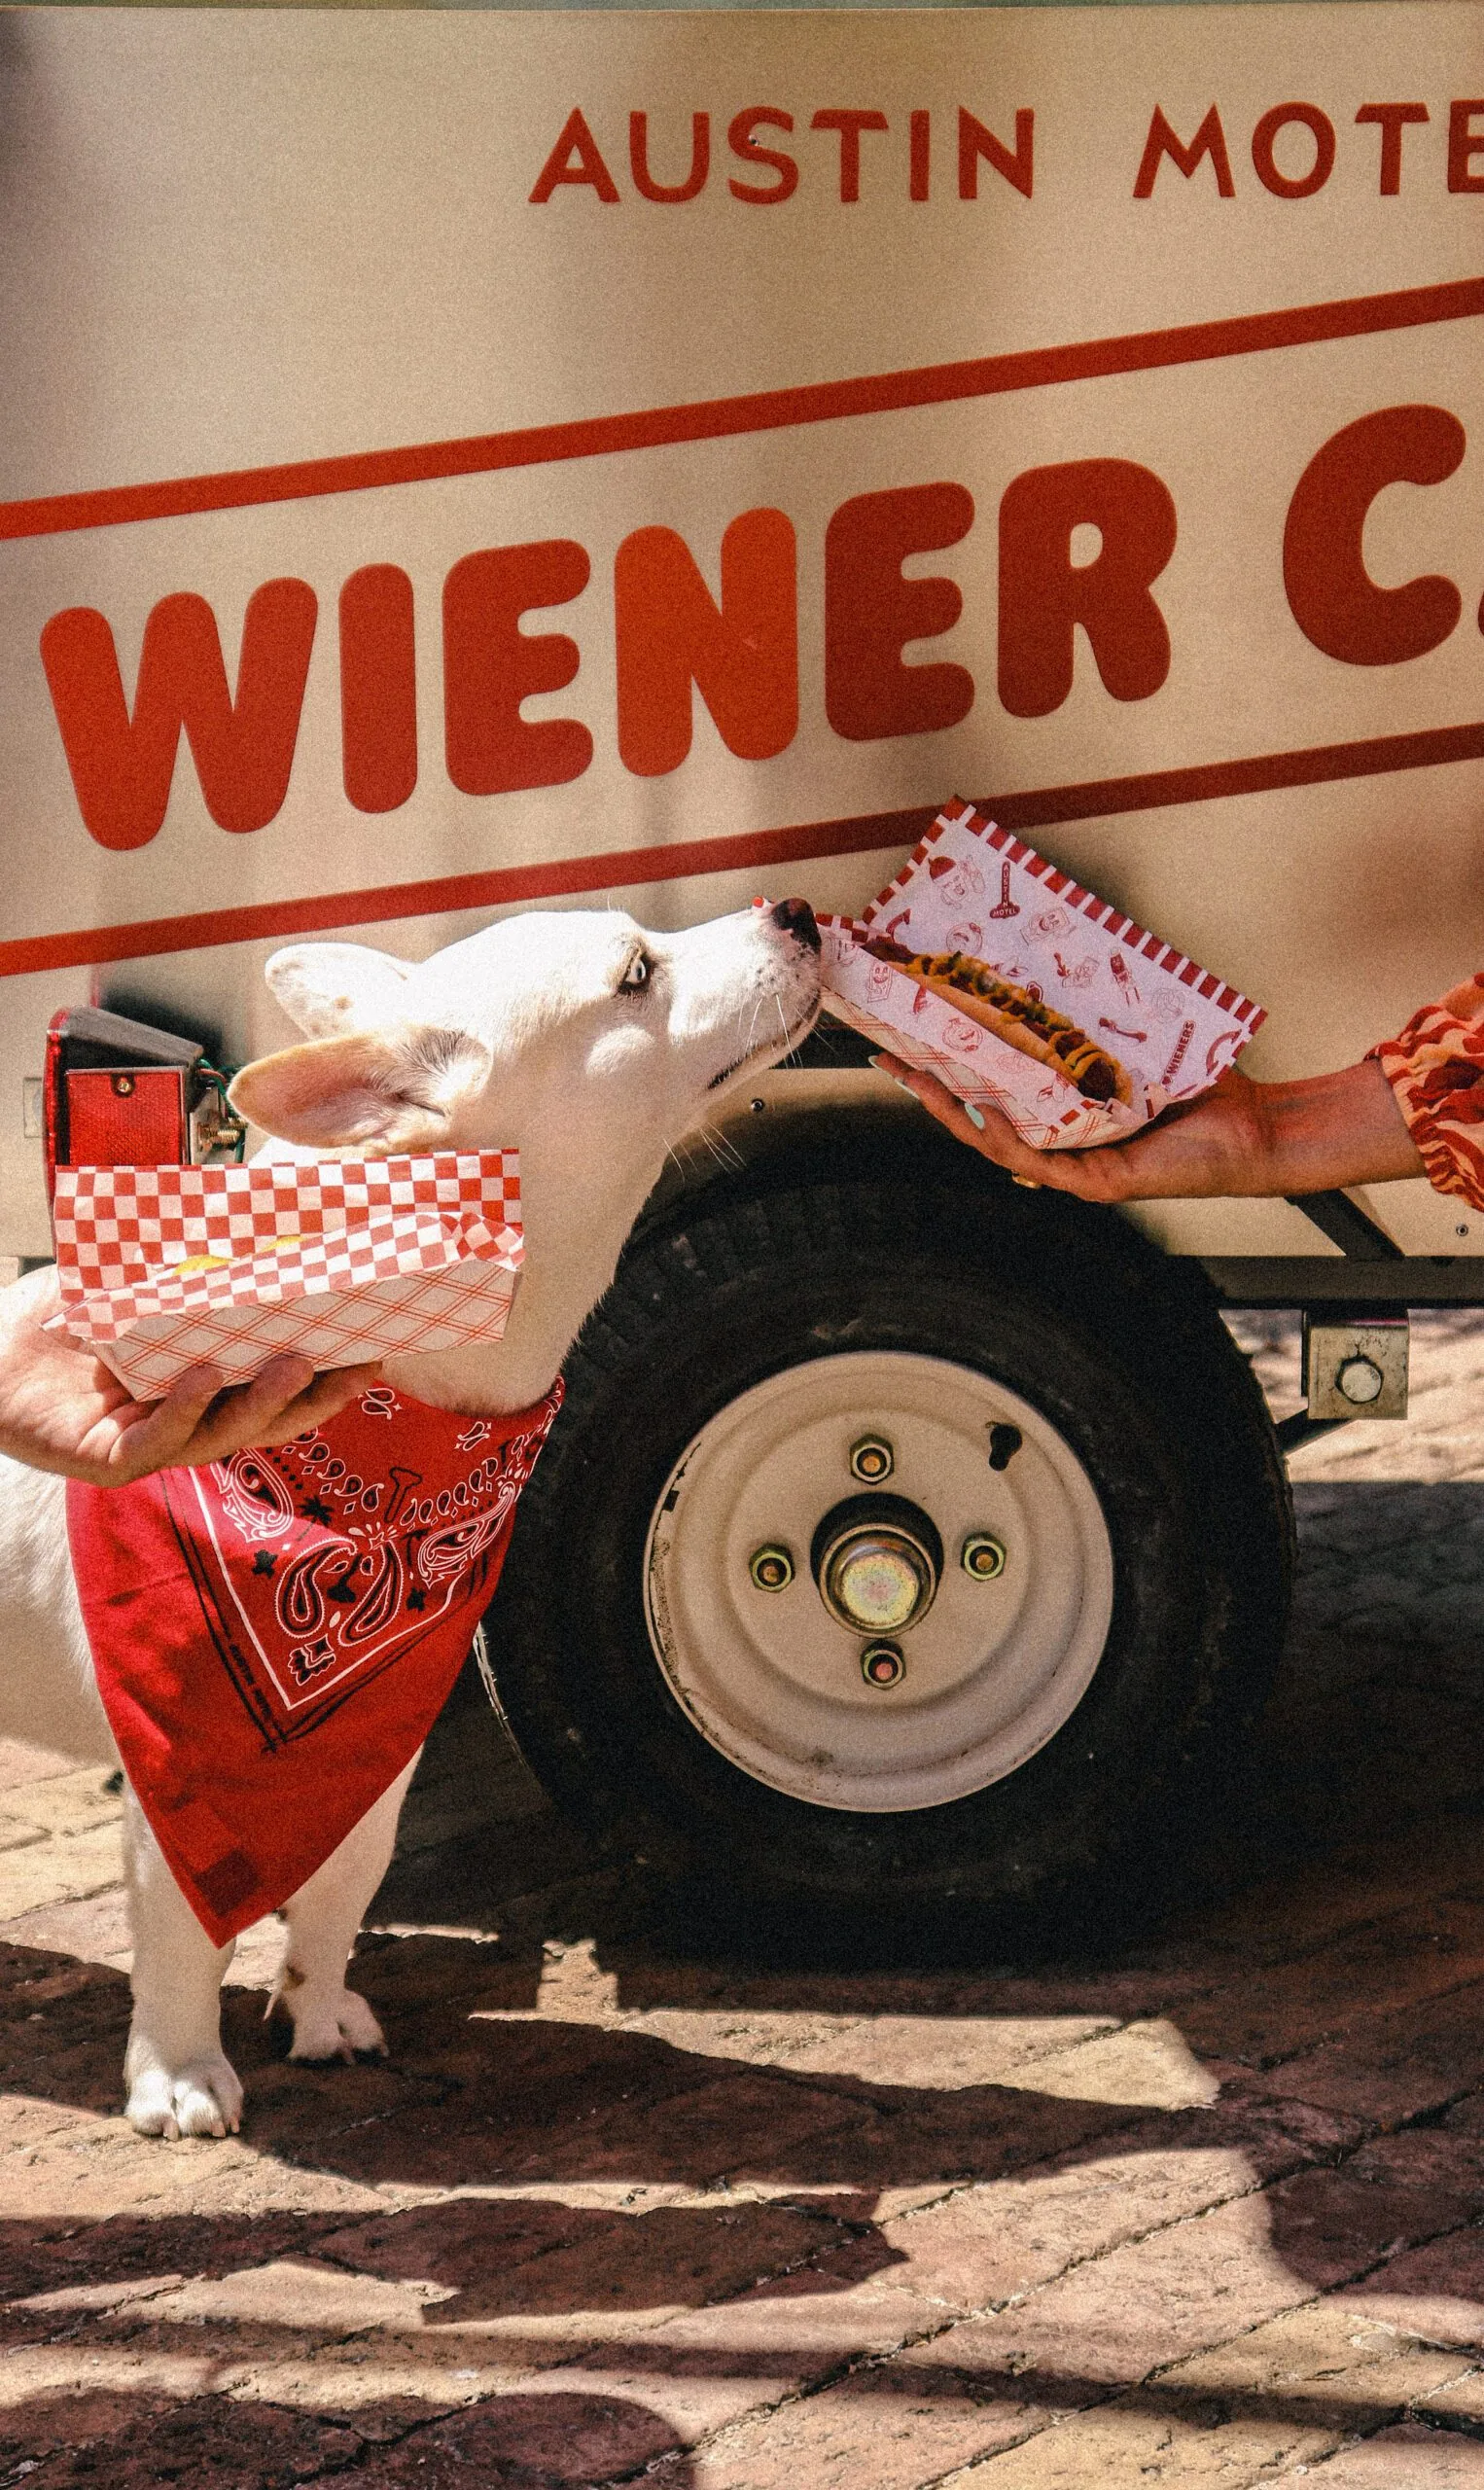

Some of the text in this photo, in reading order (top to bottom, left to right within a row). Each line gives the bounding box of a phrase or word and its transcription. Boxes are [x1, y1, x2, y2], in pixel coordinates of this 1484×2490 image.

[529, 99, 1484, 205] AUSTIN MOTE
[40, 404, 1484, 850] WIENER C
[993, 907, 1016, 917] MOTEL
[1166, 1021, 1195, 1075] WIENERS
